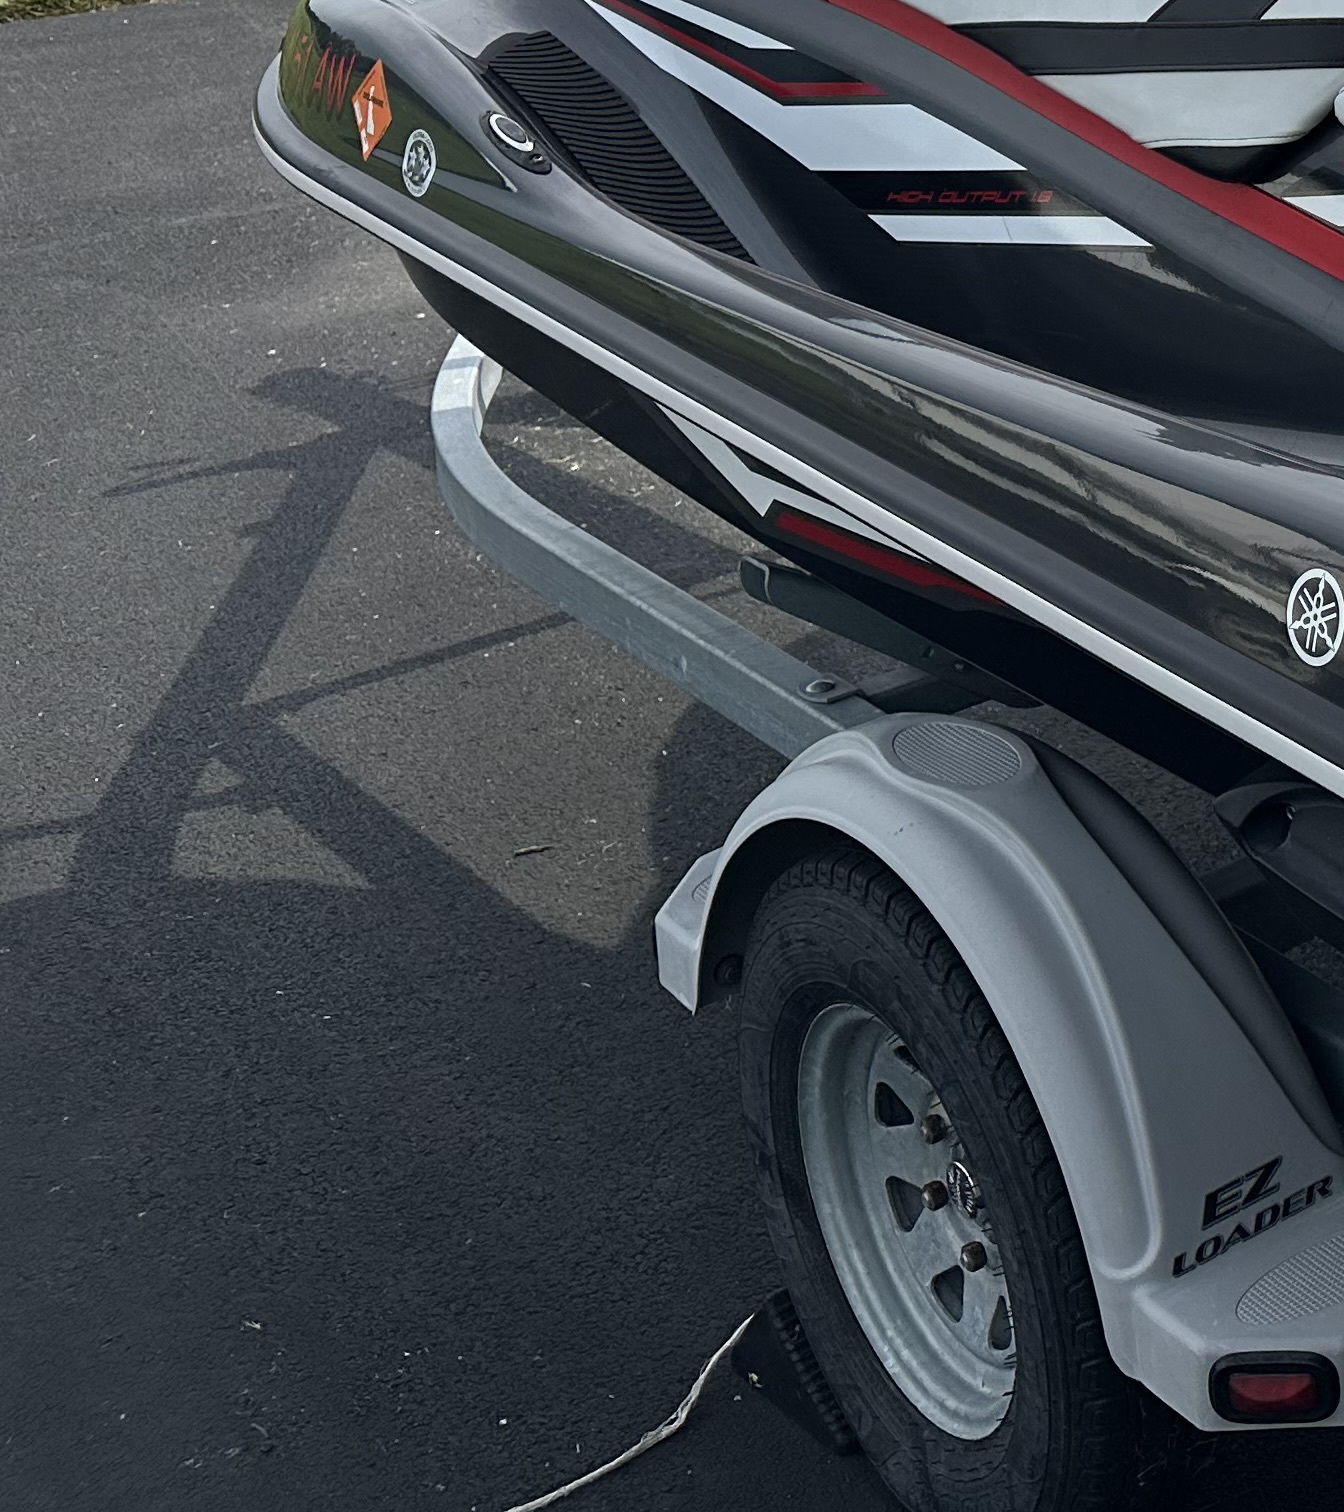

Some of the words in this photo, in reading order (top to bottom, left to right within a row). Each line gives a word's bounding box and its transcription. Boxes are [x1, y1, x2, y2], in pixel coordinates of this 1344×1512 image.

[886, 190, 934, 203] HIGH
[938, 190, 1027, 203] OUTPUT
[1172, 1175, 1333, 1278] LOADER
[1202, 1155, 1283, 1230] EZ
